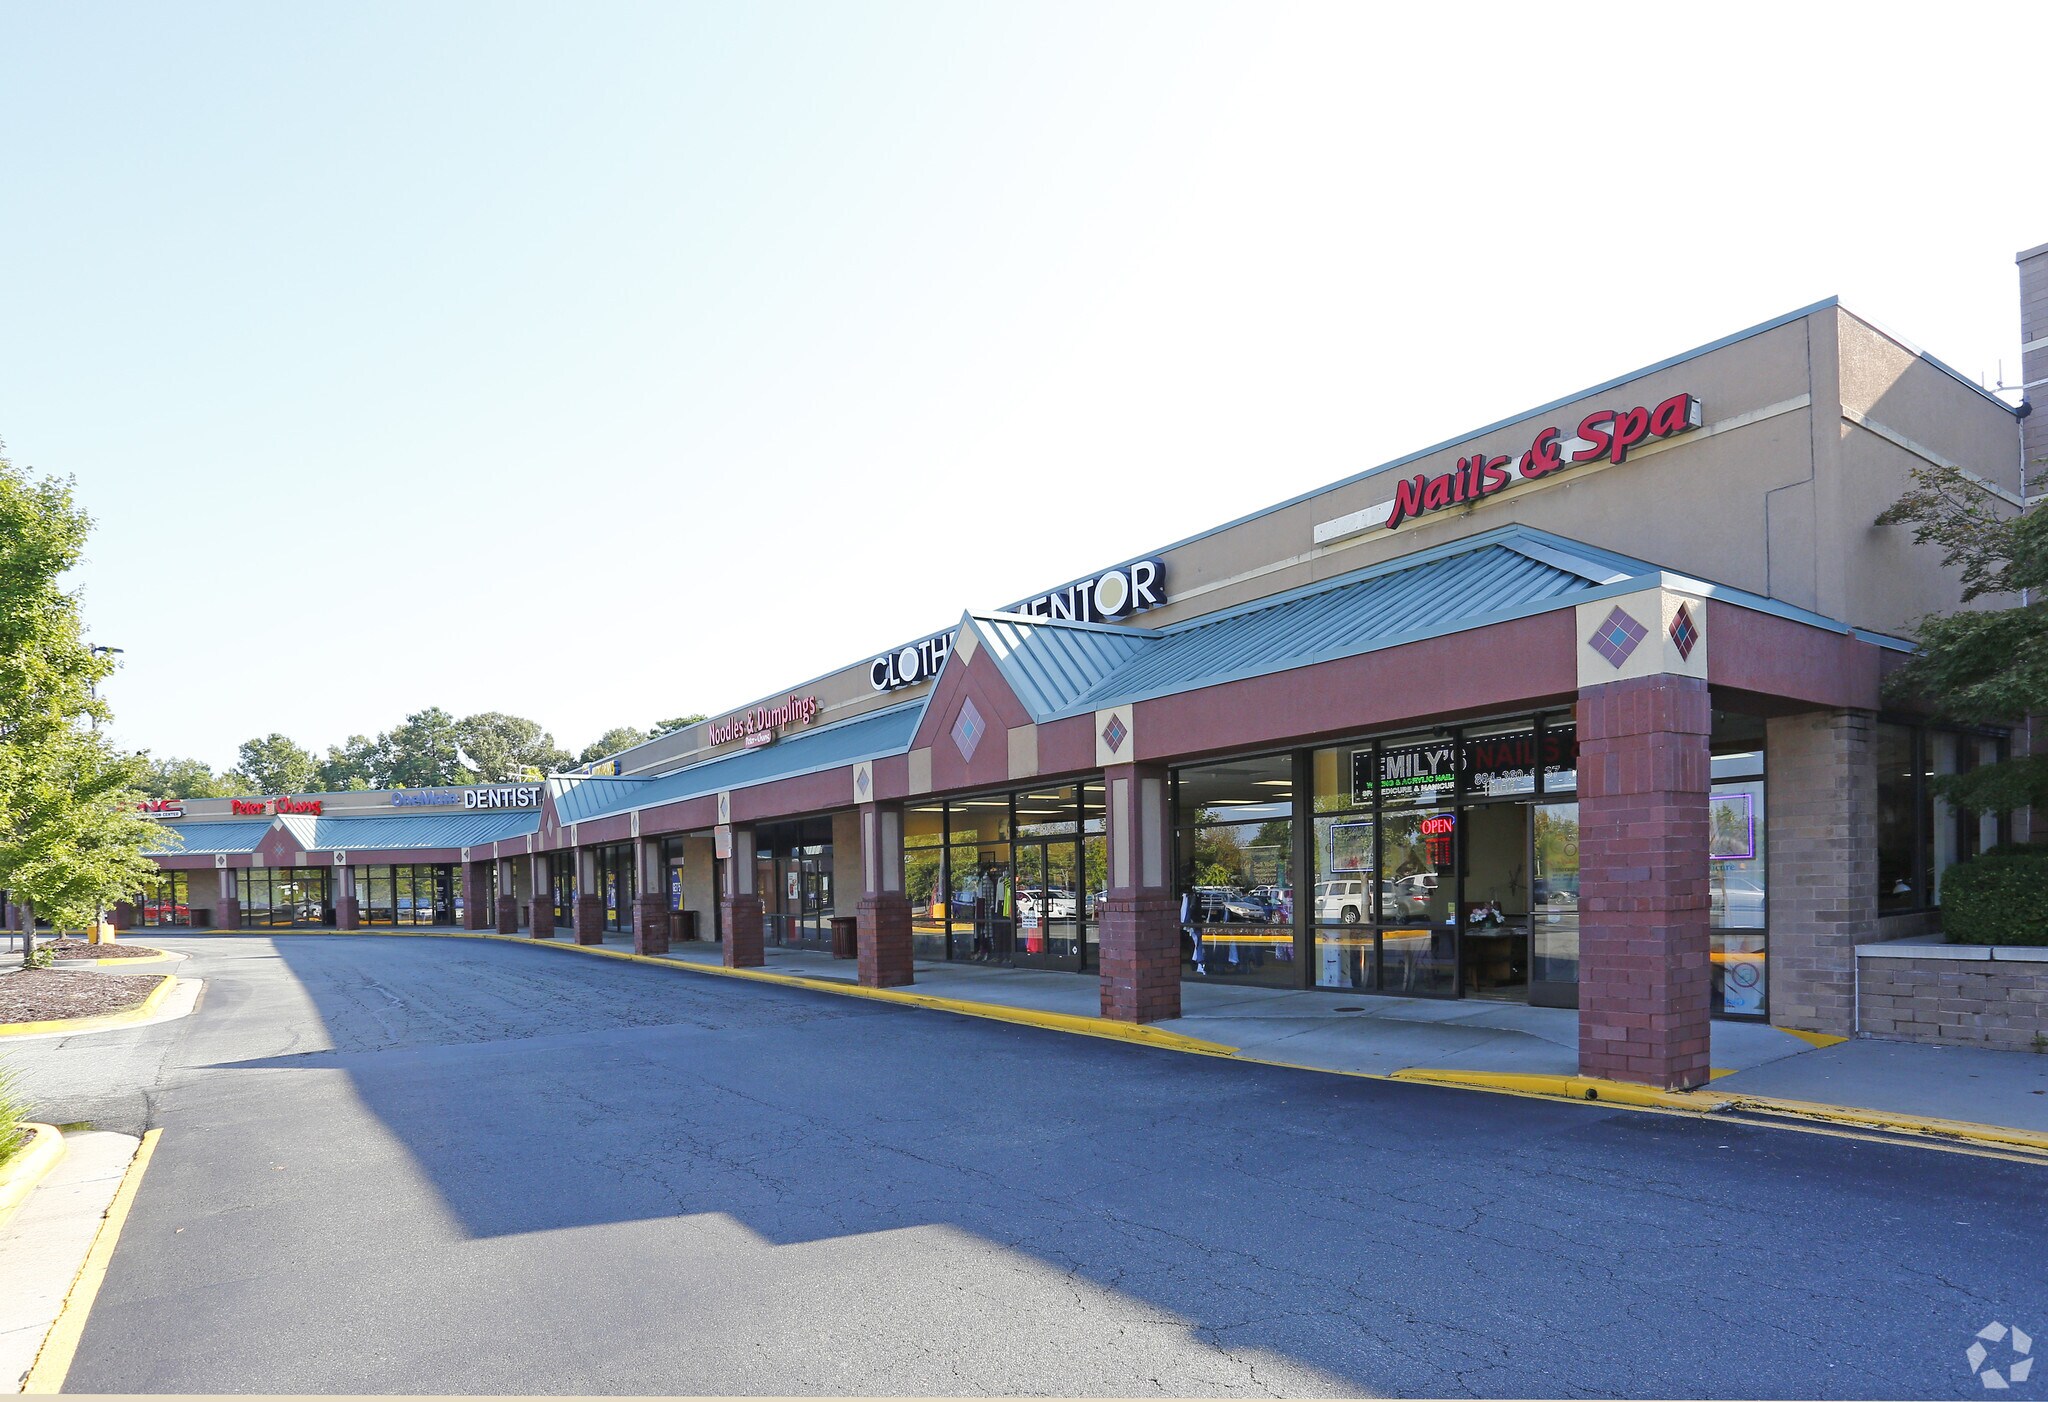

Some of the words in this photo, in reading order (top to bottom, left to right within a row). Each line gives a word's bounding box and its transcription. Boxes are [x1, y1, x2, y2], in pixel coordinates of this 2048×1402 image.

[1386, 453, 1511, 529] Nails
[1519, 427, 1564, 479] &
[1572, 392, 1691, 464] Spa
[870, 632, 956, 690] CLOTH
[709, 717, 744, 746] Noodles
[747, 710, 754, 734] &
[757, 694, 816, 731] Dumplings
[1402, 775, 1434, 785] ACRYLIC
[1435, 773, 1454, 782] NAIL
[464, 786, 541, 809] DENTIST
[1381, 785, 1412, 795] EDICURE
[1420, 782, 1454, 792] MANICUR
[230, 799, 264, 815] Peter
[276, 796, 322, 815] Chang
[391, 789, 458, 807] OneMain
[1421, 818, 1453, 835] OPEN
[1711, 863, 1736, 871] icure
